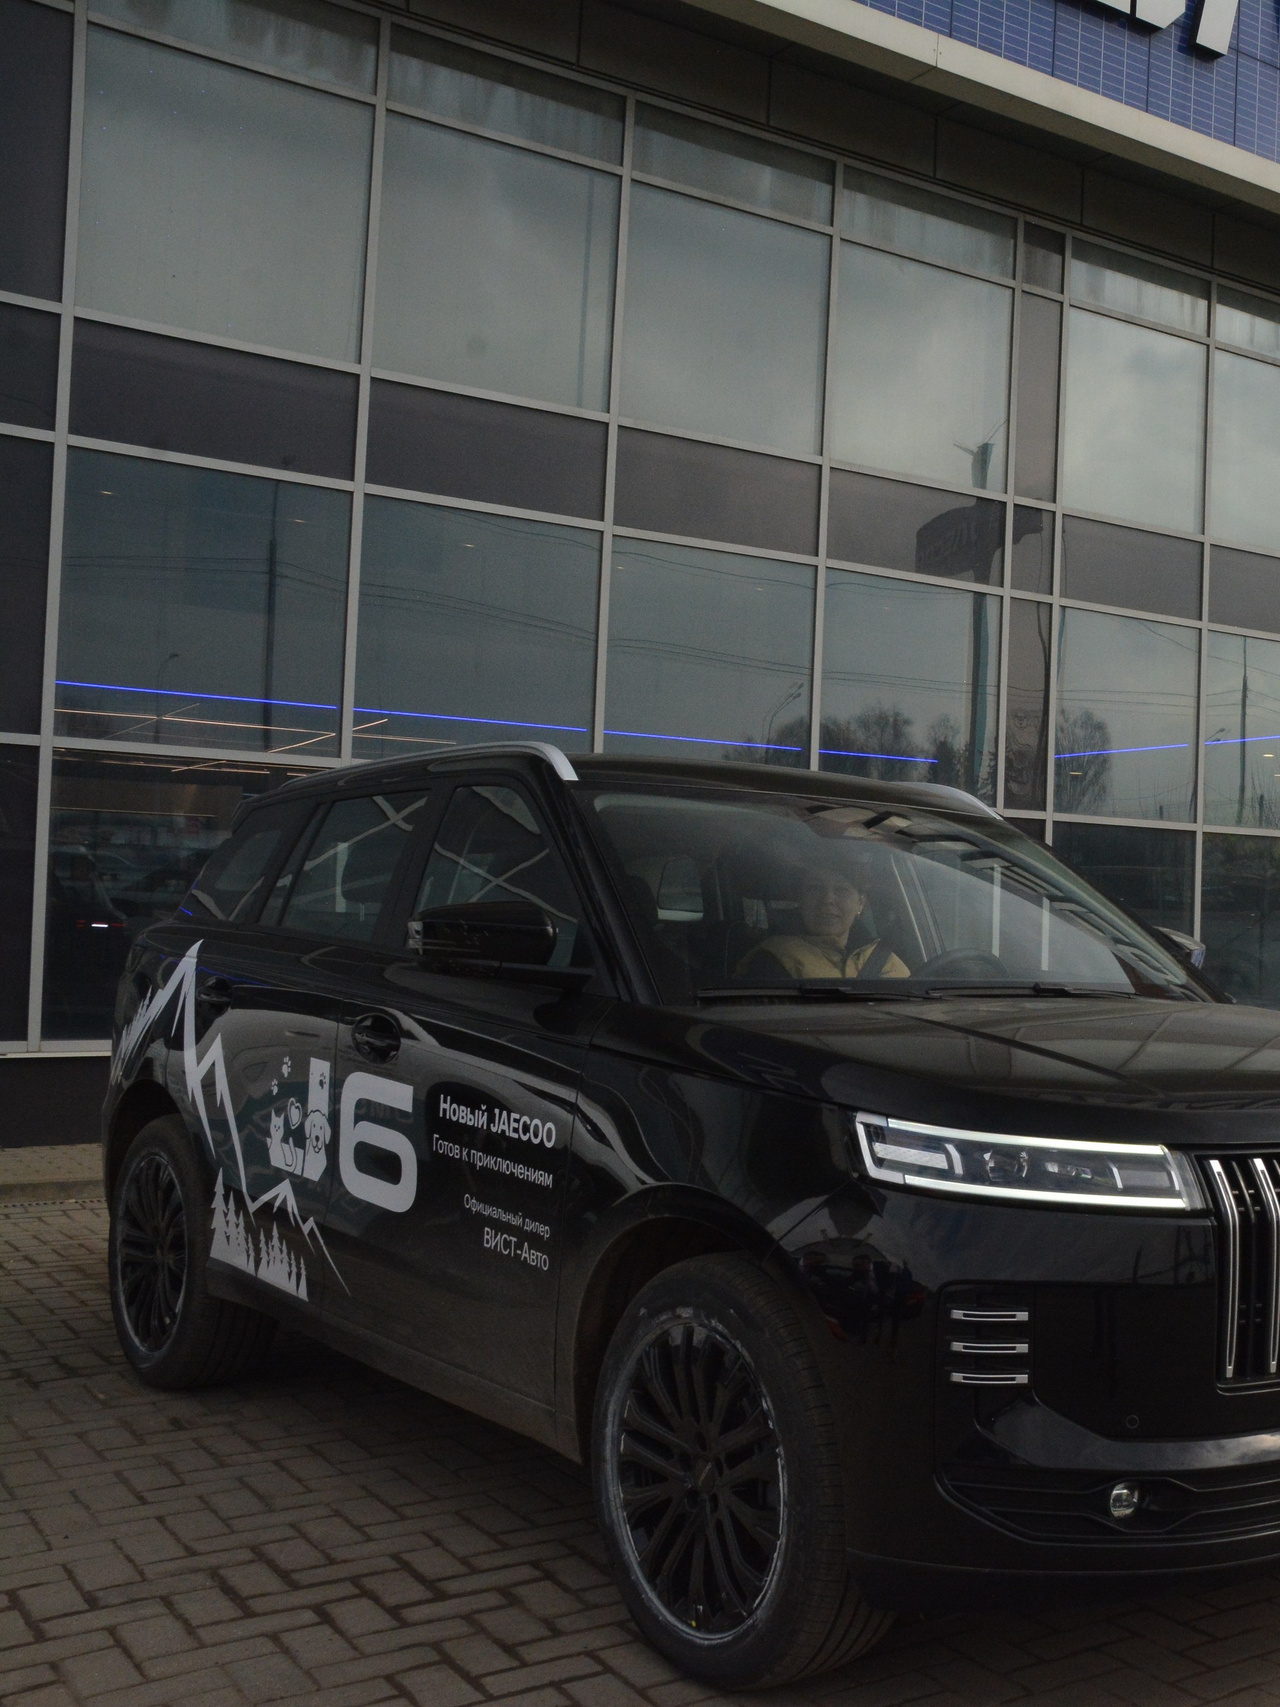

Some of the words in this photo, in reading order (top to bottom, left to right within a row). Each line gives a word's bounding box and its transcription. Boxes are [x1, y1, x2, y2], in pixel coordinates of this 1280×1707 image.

[439, 1094, 487, 1130] Новый
[490, 1109, 556, 1148] JAECOO
[433, 1134, 460, 1160] Готов
[462, 1147, 469, 1162] к
[470, 1150, 553, 1188] приключениям
[464, 1193, 523, 1227] Официальный
[524, 1217, 550, 1239] дилер
[484, 1227, 549, 1270] ВИСТ-Авто
